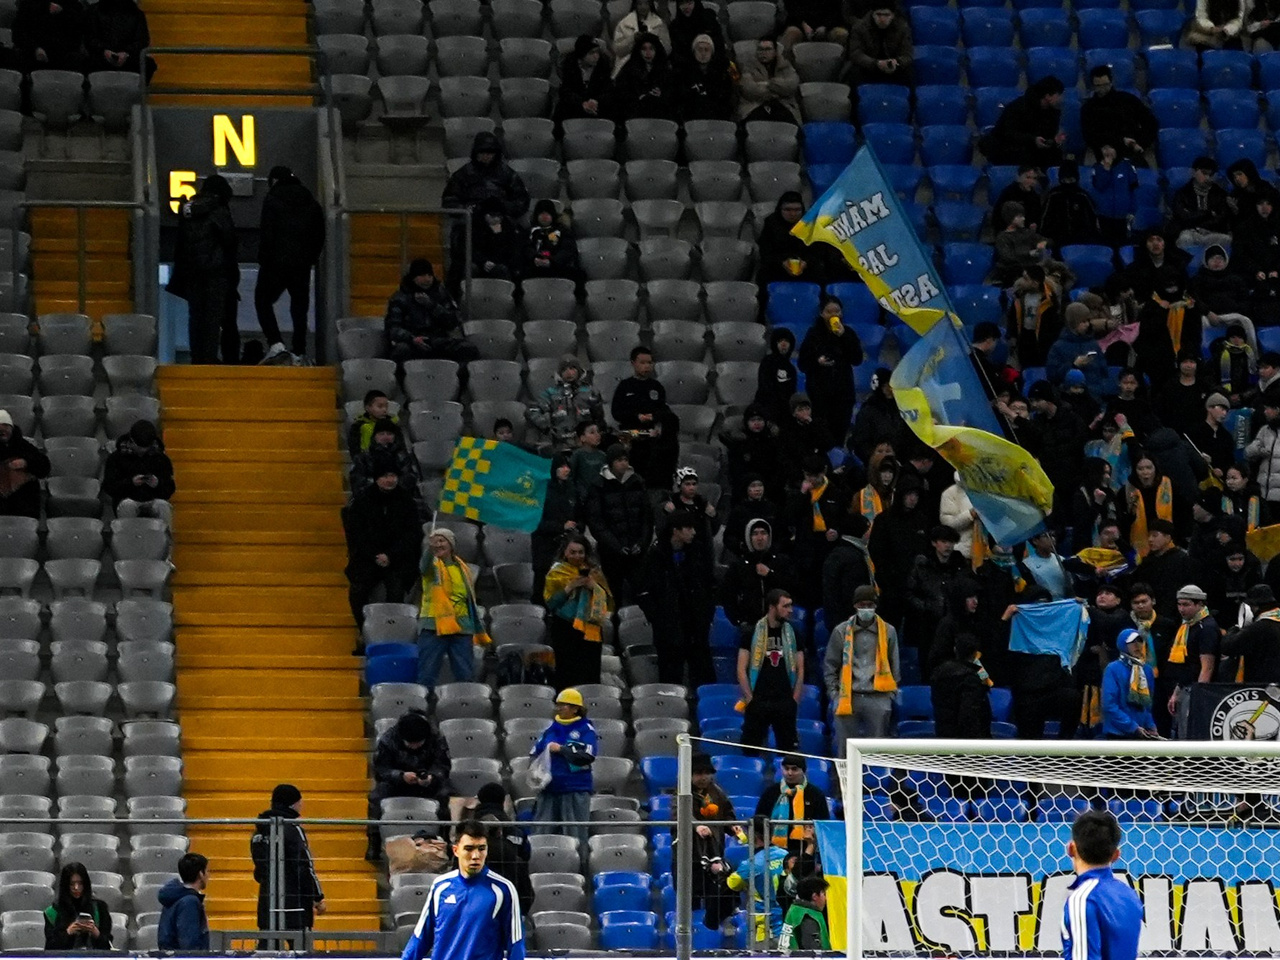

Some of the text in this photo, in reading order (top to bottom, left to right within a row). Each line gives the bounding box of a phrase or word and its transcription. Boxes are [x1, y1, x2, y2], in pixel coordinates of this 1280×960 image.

[212, 114, 256, 167] N
[1212, 690, 1260, 737] OLD BOYS
